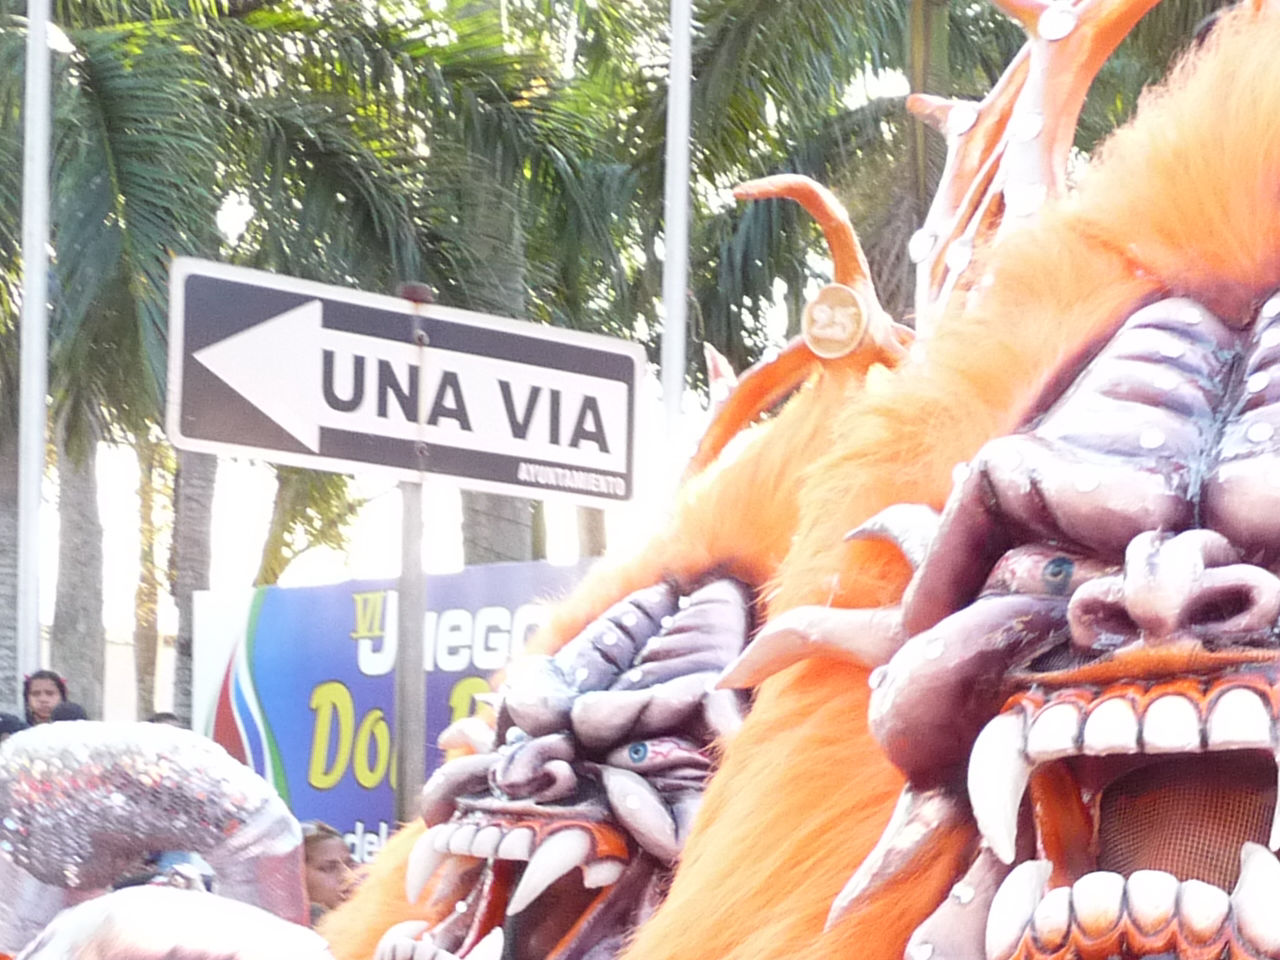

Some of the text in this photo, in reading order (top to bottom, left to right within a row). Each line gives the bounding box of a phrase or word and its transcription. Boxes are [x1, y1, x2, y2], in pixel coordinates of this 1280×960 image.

[810, 304, 857, 341] 25
[322, 349, 611, 454] UNA VIA
[517, 462, 626, 496] AYUNTAMIENTO
[308, 680, 398, 790] Do
